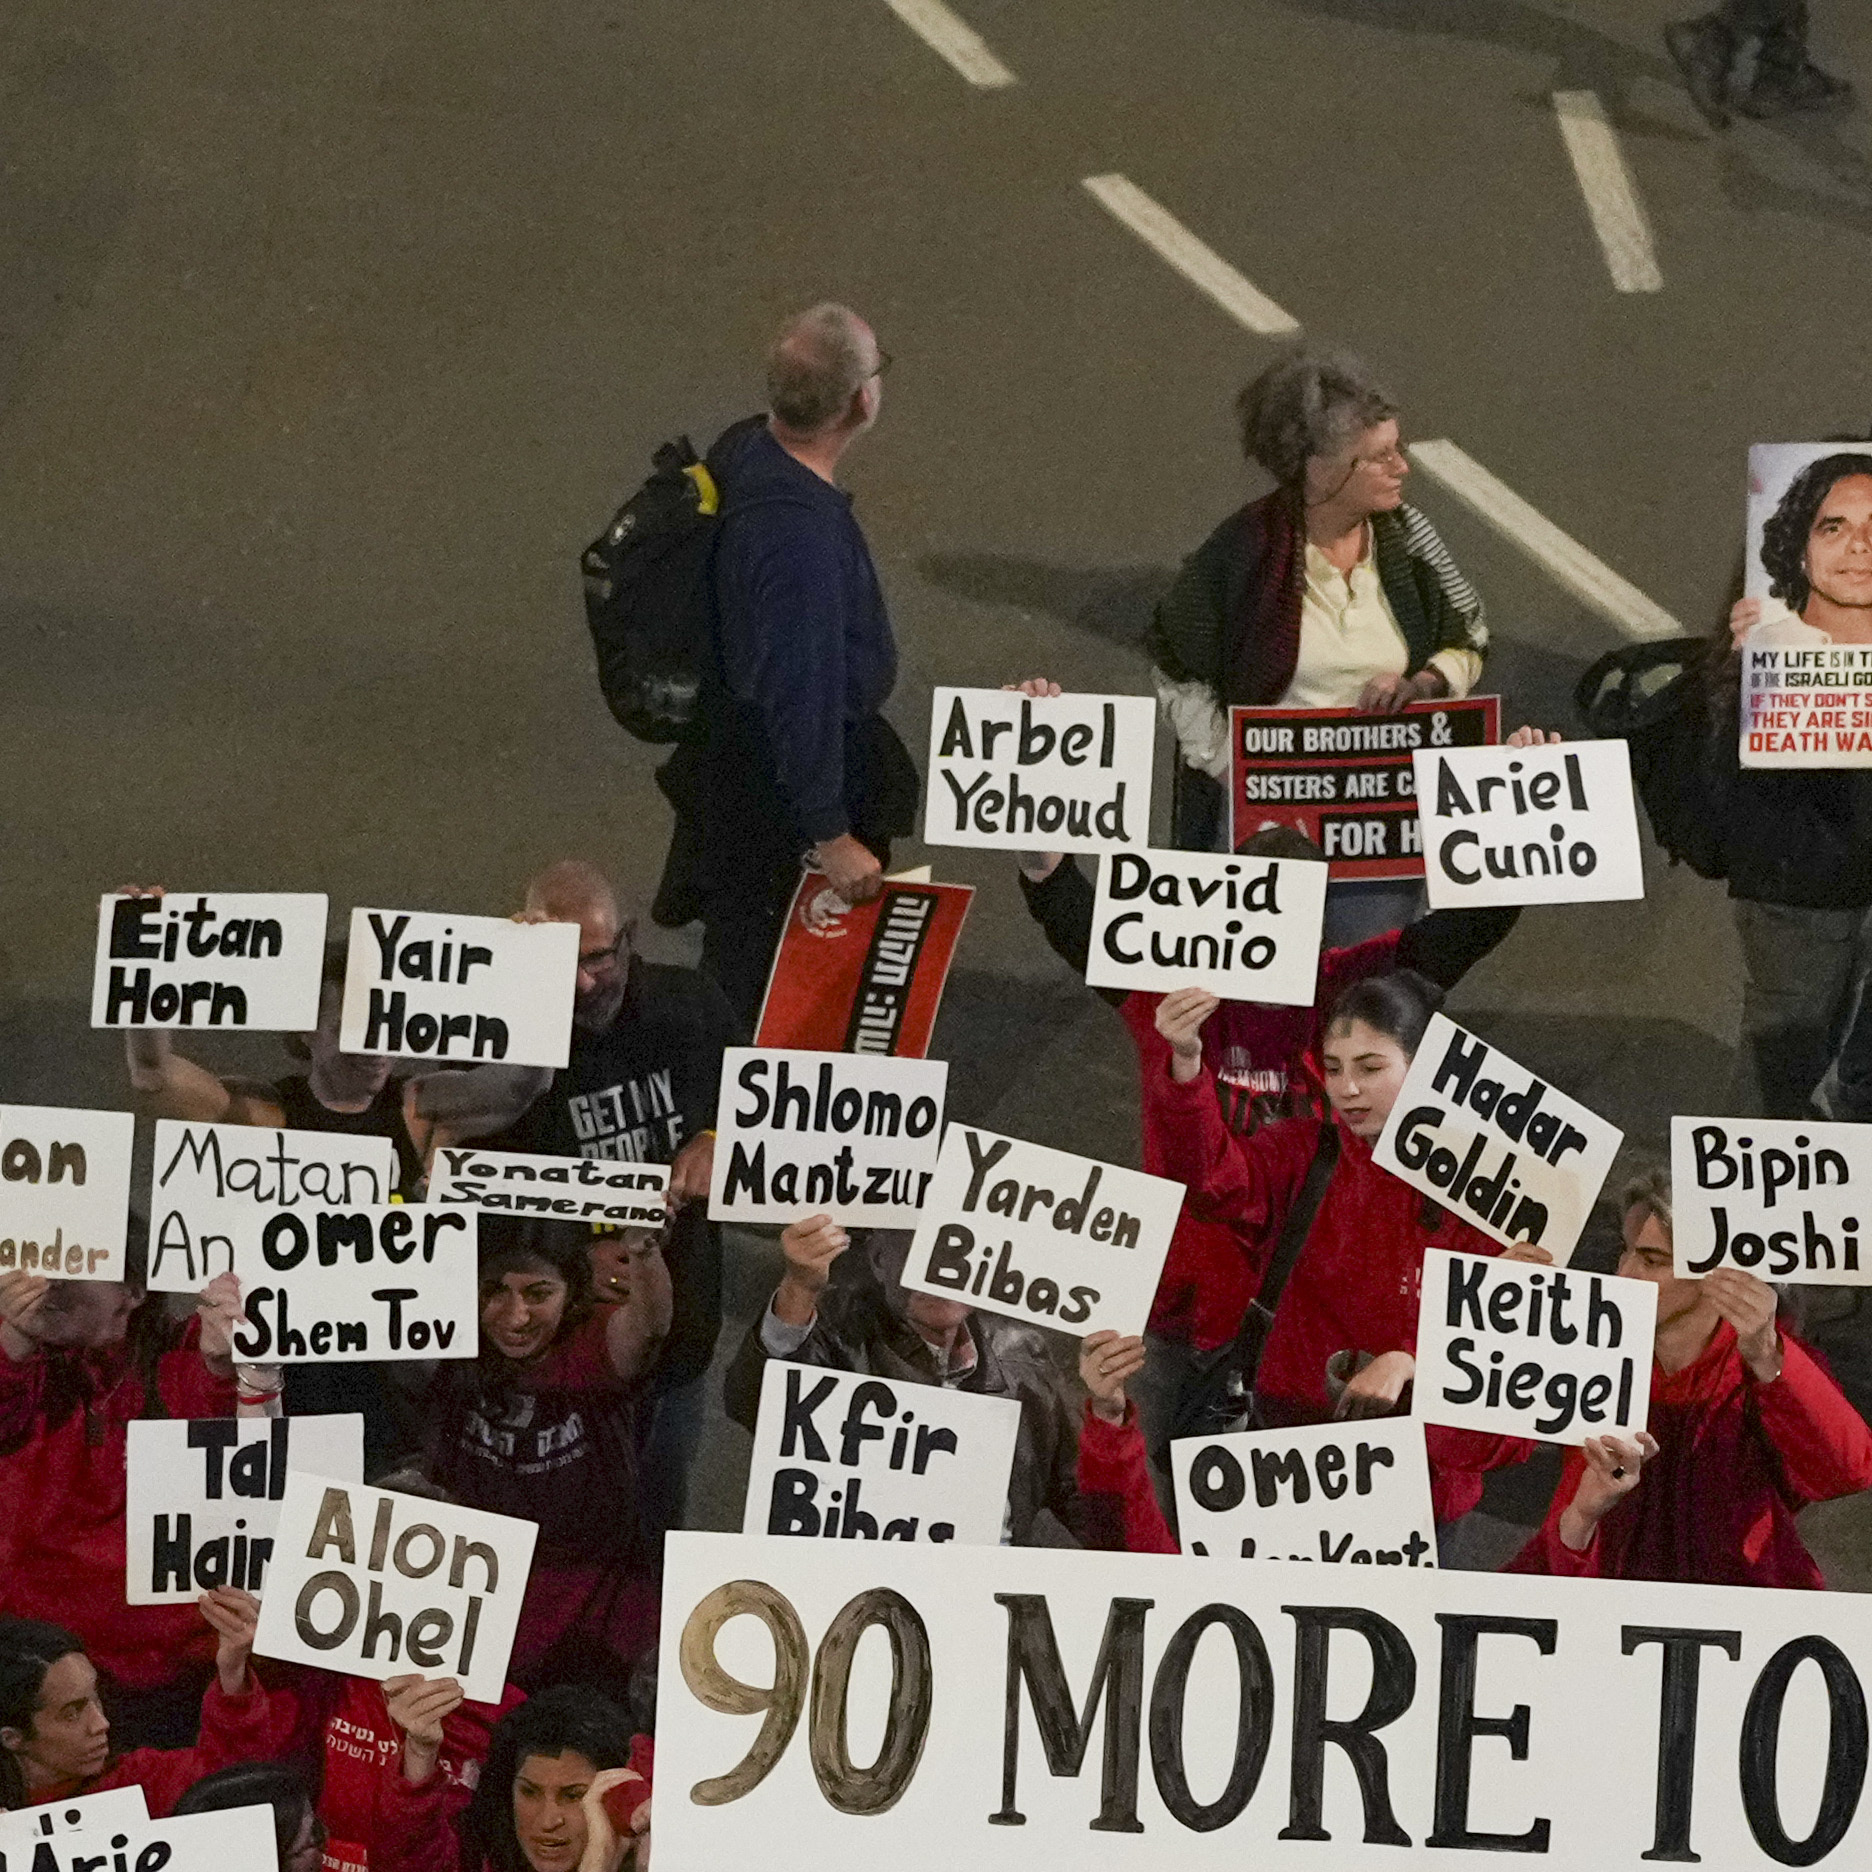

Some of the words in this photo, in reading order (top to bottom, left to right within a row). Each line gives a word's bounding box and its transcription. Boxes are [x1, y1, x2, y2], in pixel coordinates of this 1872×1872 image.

[1752, 652, 1779, 668] MY
[1785, 652, 1824, 668] LIFE
[1784, 672, 1849, 687] ISRAELI
[937, 696, 1114, 768] Arbel
[1245, 724, 1293, 754] OUR
[1303, 720, 1420, 752] BROTHERS
[1430, 713, 1453, 747] &
[1752, 712, 1801, 729] THEY
[1806, 712, 1845, 728] ARE
[1770, 693, 1810, 707] THEY
[1814, 693, 1860, 707] DON'T
[1749, 732, 1828, 752] DEATH
[939, 768, 1132, 843] Yehoud
[1245, 773, 1336, 801] SISTERS
[1344, 771, 1389, 798] ARE
[1324, 820, 1392, 858] FOR
[1438, 823, 1598, 885] Cunio
[108, 897, 282, 963] Eitan
[367, 913, 493, 985] Yair
[1102, 908, 1277, 971] Cunio
[104, 965, 248, 1027] Horn
[363, 987, 510, 1060] Horn
[568, 1083, 627, 1140] GET
[734, 1058, 940, 1140] Shlomo
[1428, 1027, 1589, 1167] Hadar
[159, 1128, 380, 1204] Matan
[440, 1149, 665, 1193] Yonatan
[963, 1130, 1141, 1250] Yarden
[1693, 1125, 1850, 1208] Bipin
[439, 1183, 668, 1225] Samerano
[926, 1223, 1102, 1325] Bibas
[1686, 1206, 1861, 1275] Joshi
[1445, 1258, 1624, 1350] Keith
[1442, 1336, 1633, 1437] Siegel
[777, 1370, 958, 1475] Kfir
[305, 1487, 501, 1595] Alon
[295, 1568, 483, 1677] Ohel
[677, 1577, 936, 1818] 90
[988, 1590, 1560, 1855] MORE
[1620, 1624, 1872, 1868] TO
